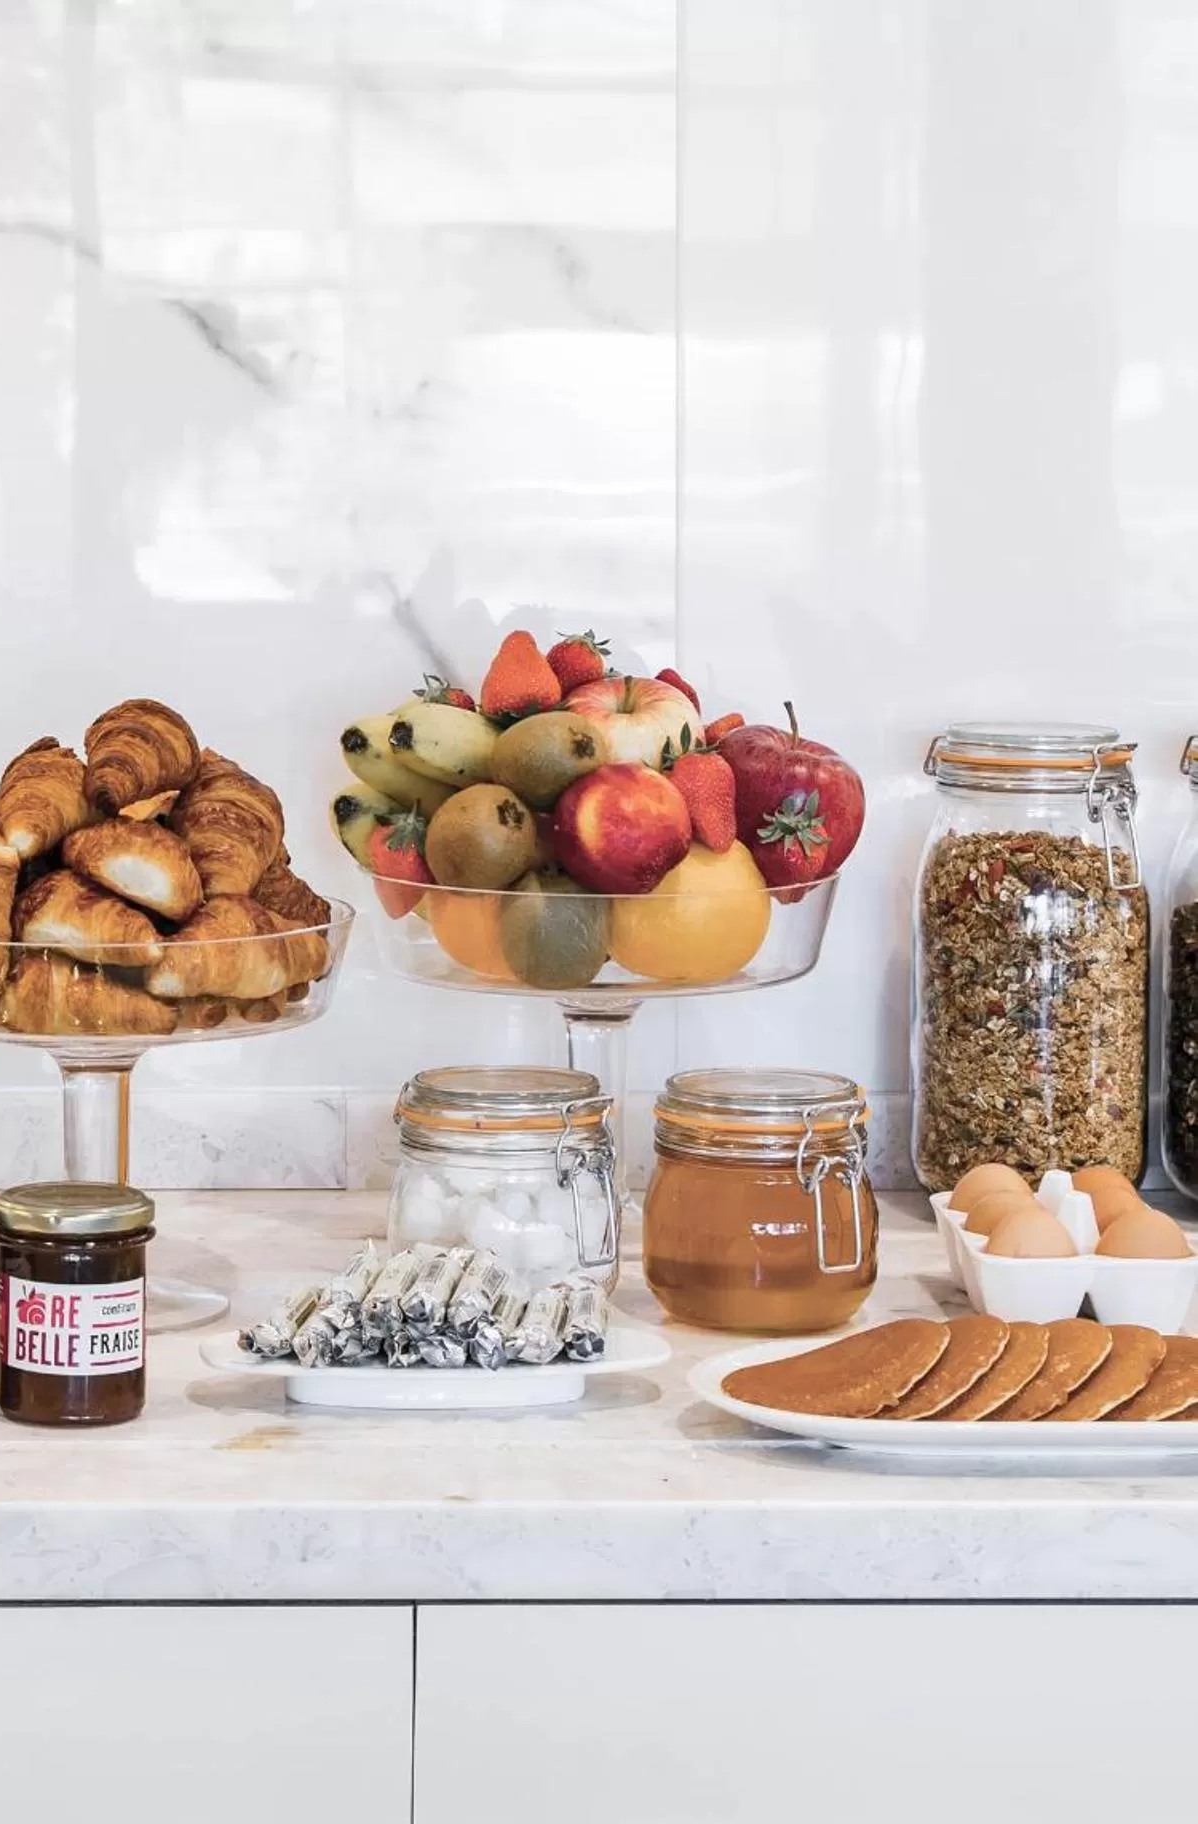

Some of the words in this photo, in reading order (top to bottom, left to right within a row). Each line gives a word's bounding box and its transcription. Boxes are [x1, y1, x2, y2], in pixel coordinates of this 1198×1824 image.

[50, 1295, 81, 1328] RE
[15, 1327, 81, 1367] BELLE
[89, 1329, 140, 1354] FRAISE
